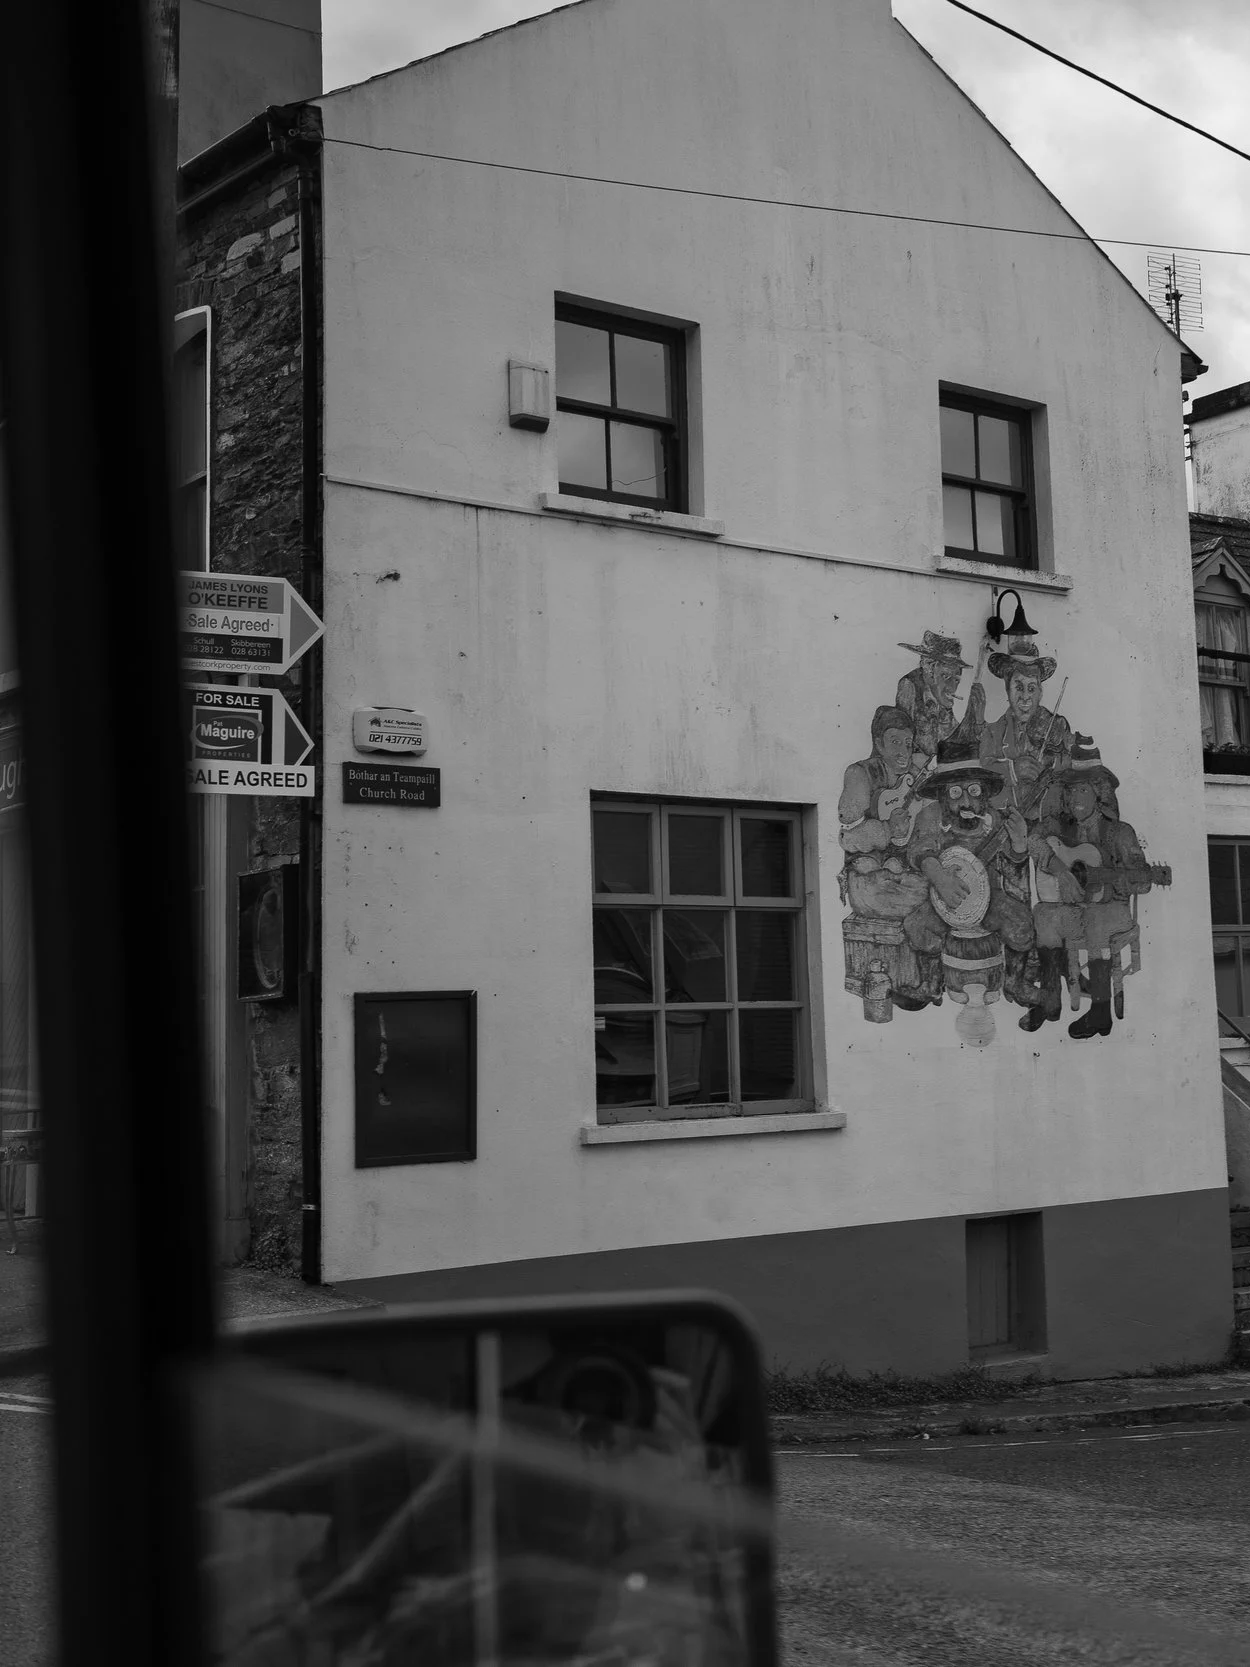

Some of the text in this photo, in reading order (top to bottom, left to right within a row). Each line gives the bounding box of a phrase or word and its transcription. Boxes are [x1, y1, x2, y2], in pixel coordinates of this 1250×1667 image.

[188, 580, 268, 594] JAMES LYONS
[188, 591, 268, 609] O'KEEFFE
[187, 613, 270, 633] Sale Agreed
[193, 635, 271, 648] Schull Skibbereen
[200, 645, 224, 654] 28122
[231, 646, 246, 656] 028
[248, 648, 271, 657] 63131
[185, 659, 271, 671] estcorkproperty.com
[195, 692, 260, 707] FOR SALE
[200, 723, 255, 740] Maguire
[369, 733, 422, 746] 021 4377759
[201, 750, 251, 759] PROPERTIES
[233, 770, 308, 788] AGREED
[380, 773, 391, 782] an
[393, 771, 435, 786] Teampaill
[359, 786, 425, 801] Church Road
